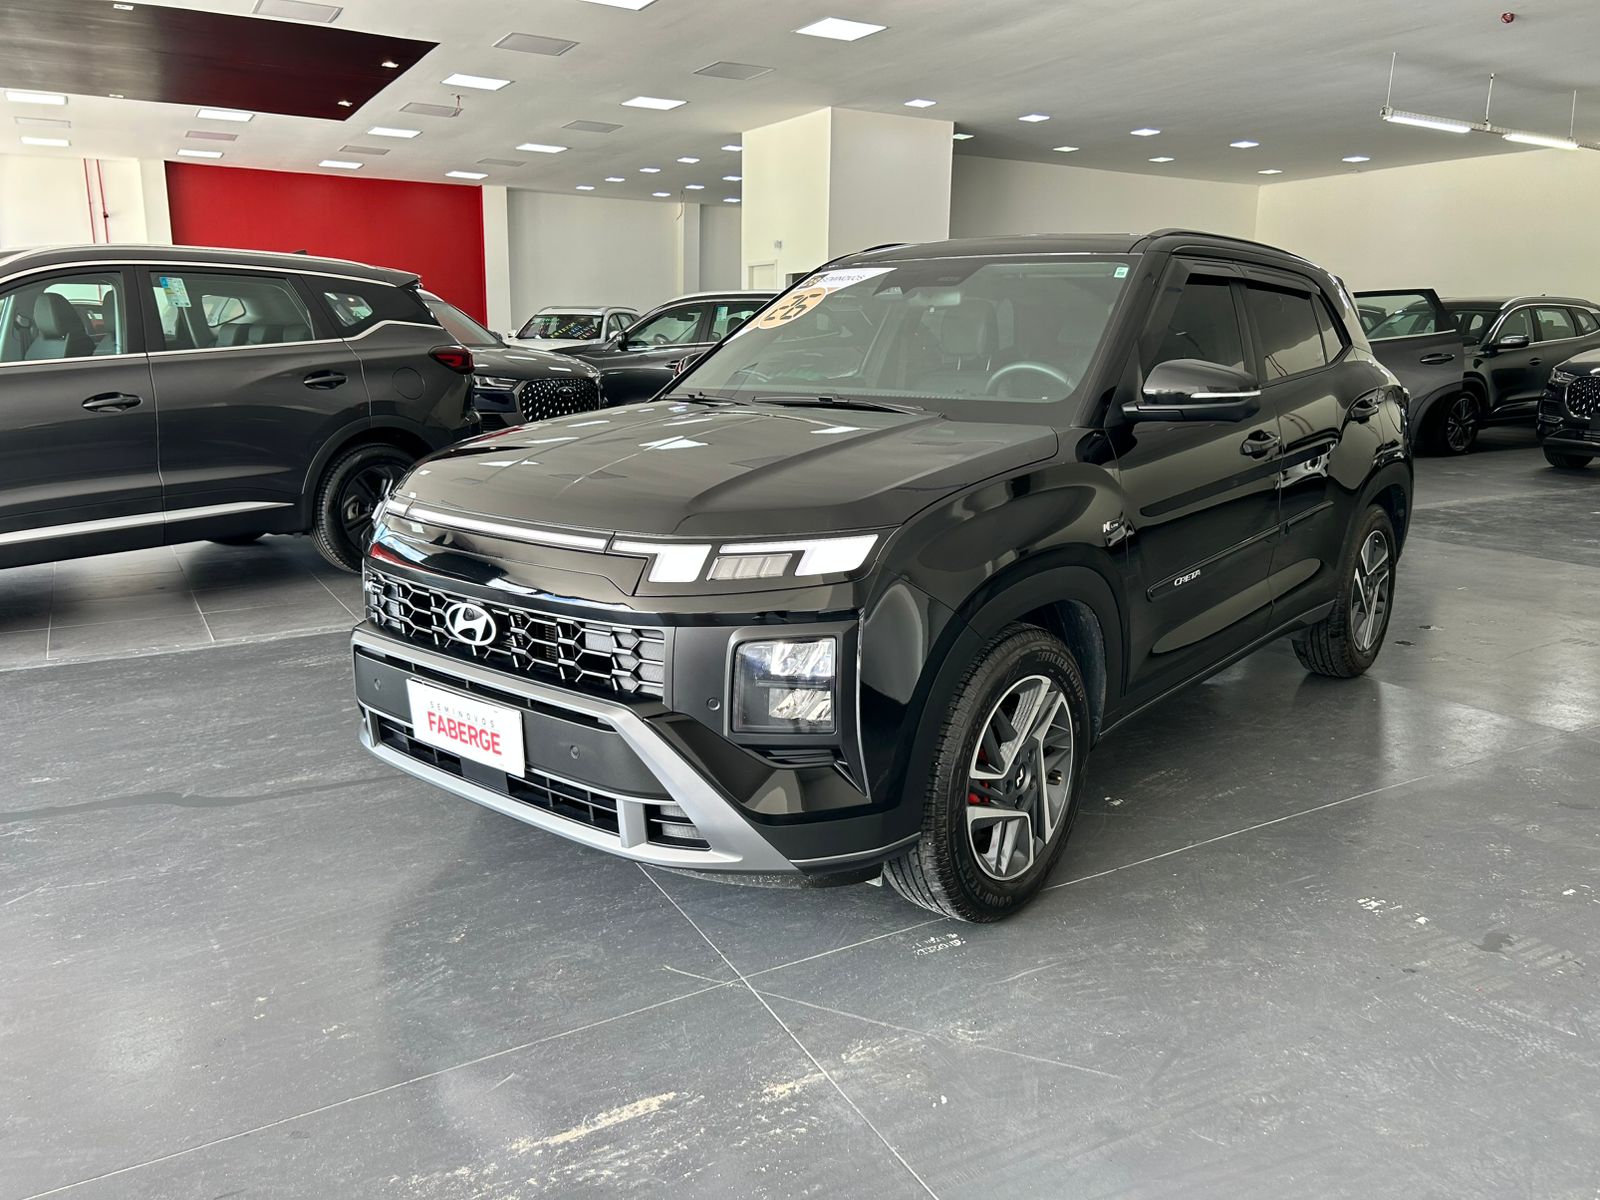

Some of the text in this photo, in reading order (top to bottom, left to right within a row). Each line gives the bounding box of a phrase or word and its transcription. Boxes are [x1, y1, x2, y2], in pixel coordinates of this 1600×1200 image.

[763, 293, 822, 322] 26
[1174, 569, 1201, 587] CRETA
[429, 700, 495, 729] SEMINOVOS
[427, 710, 503, 756] FABERGE
